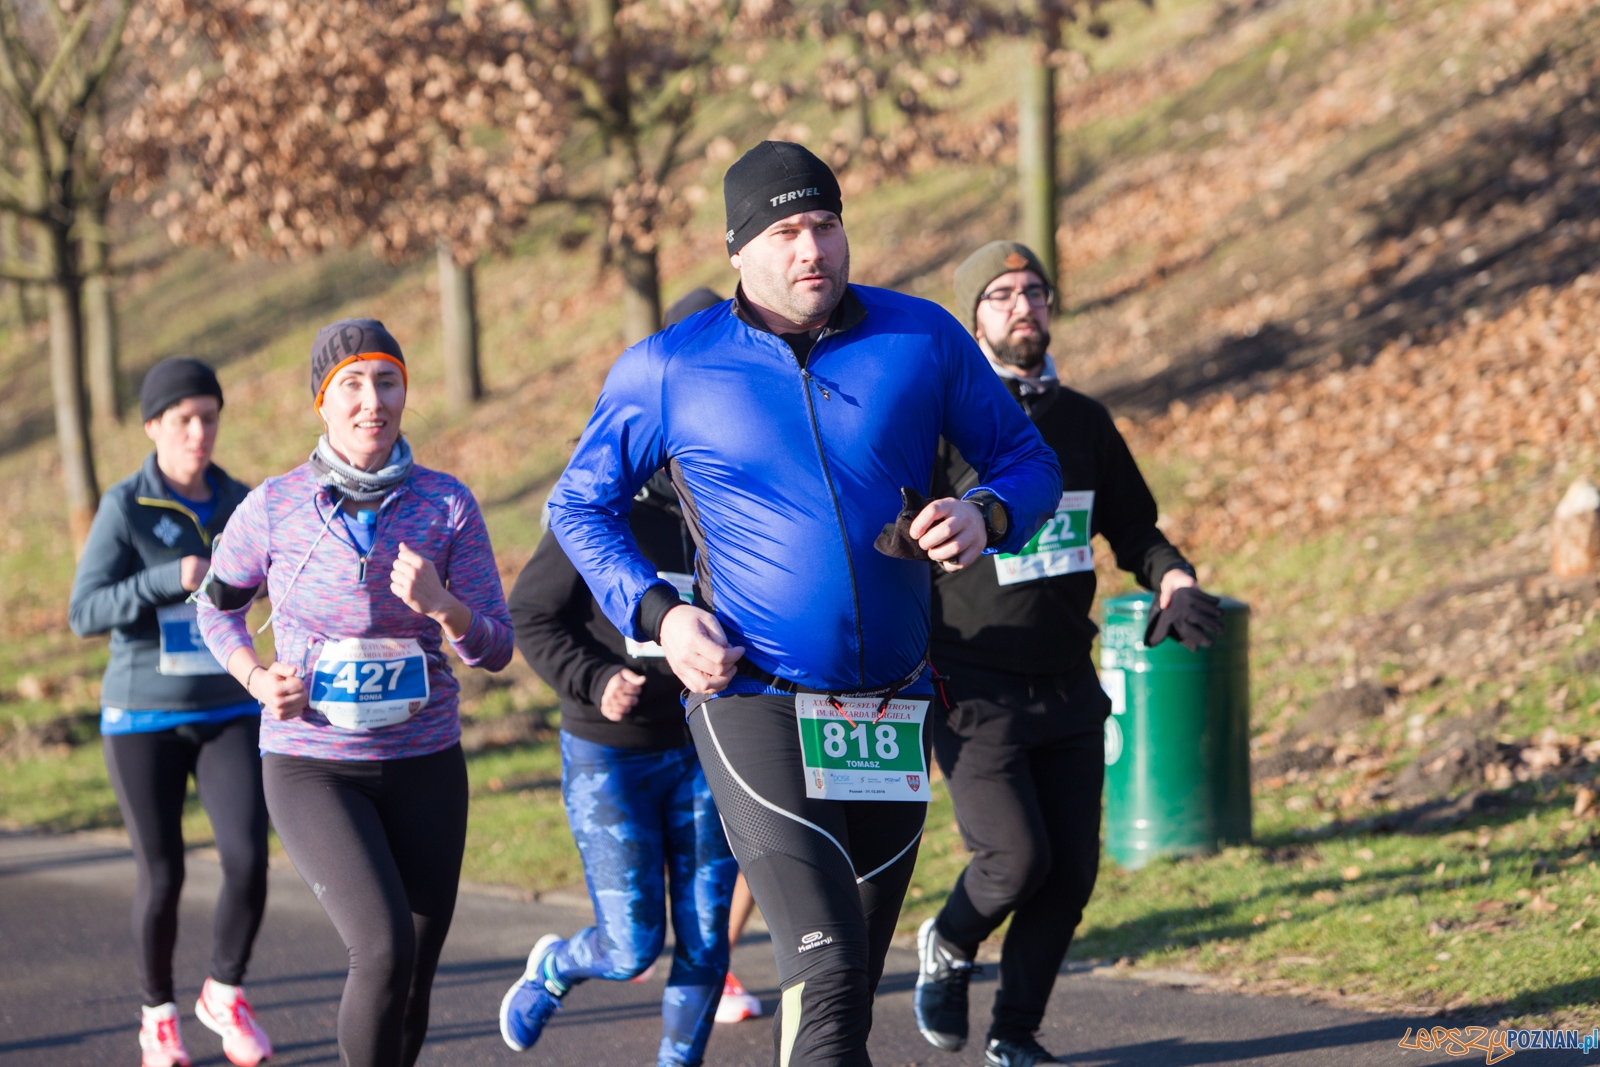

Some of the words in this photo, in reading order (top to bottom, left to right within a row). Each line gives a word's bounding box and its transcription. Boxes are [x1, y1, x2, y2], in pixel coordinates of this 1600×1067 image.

[770, 187, 820, 207] TERVEL
[1023, 513, 1075, 547] 22
[333, 660, 406, 694] 427
[857, 702, 918, 711] SYLWTROWY
[823, 722, 899, 760] 818
[846, 760, 880, 768] TOMASZ
[797, 936, 833, 953] Kalenji
